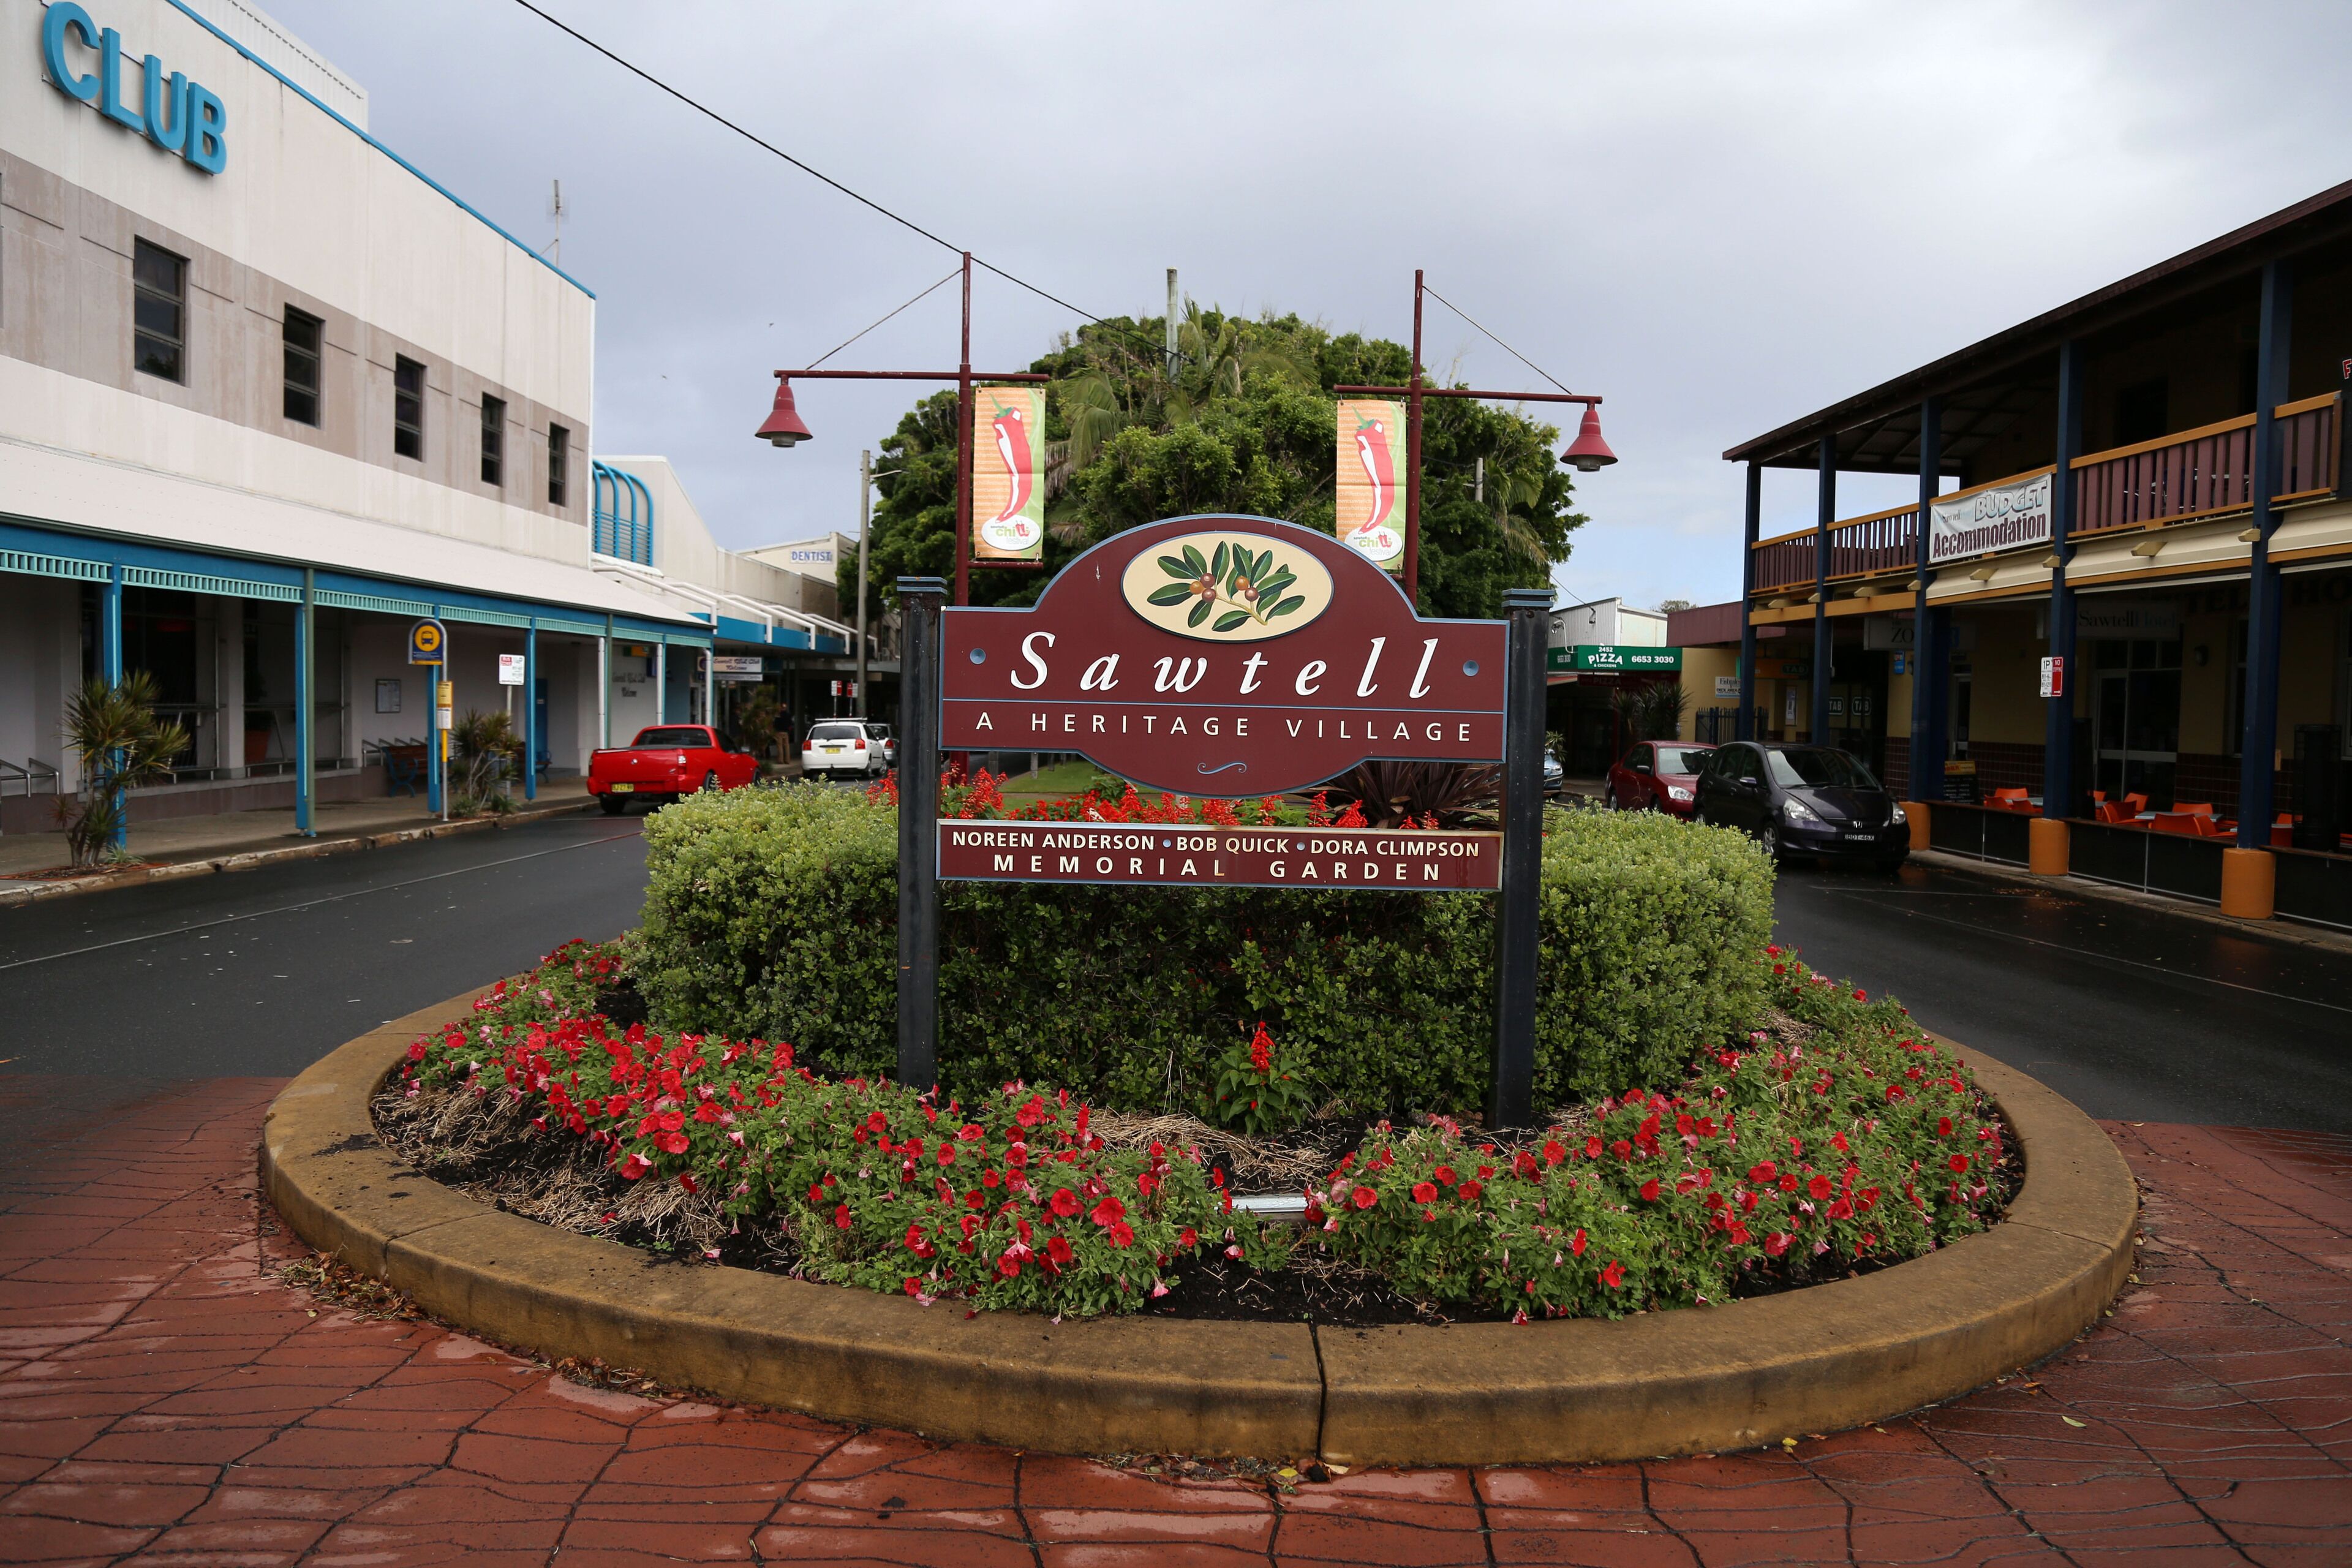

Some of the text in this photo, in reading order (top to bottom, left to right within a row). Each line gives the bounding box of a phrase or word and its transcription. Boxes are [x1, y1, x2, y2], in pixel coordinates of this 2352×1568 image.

[43, 1, 227, 175] CLUB
[1975, 480, 2048, 522] BUDGET
[1932, 513, 2046, 559] Accommodation
[1011, 631, 1439, 699] Sawtell
[1588, 653, 1623, 665] PIZZA
[2043, 660, 2050, 669] 1P
[1828, 700, 1842, 711] TAB
[976, 712, 1471, 742] A HERITAGE VILLAGE
[952, 831, 1480, 857] NOREEN ANDERSON BOB QUICK DORA CLIMPSON
[993, 854, 1440, 881] MEMORIAL GARDEN
